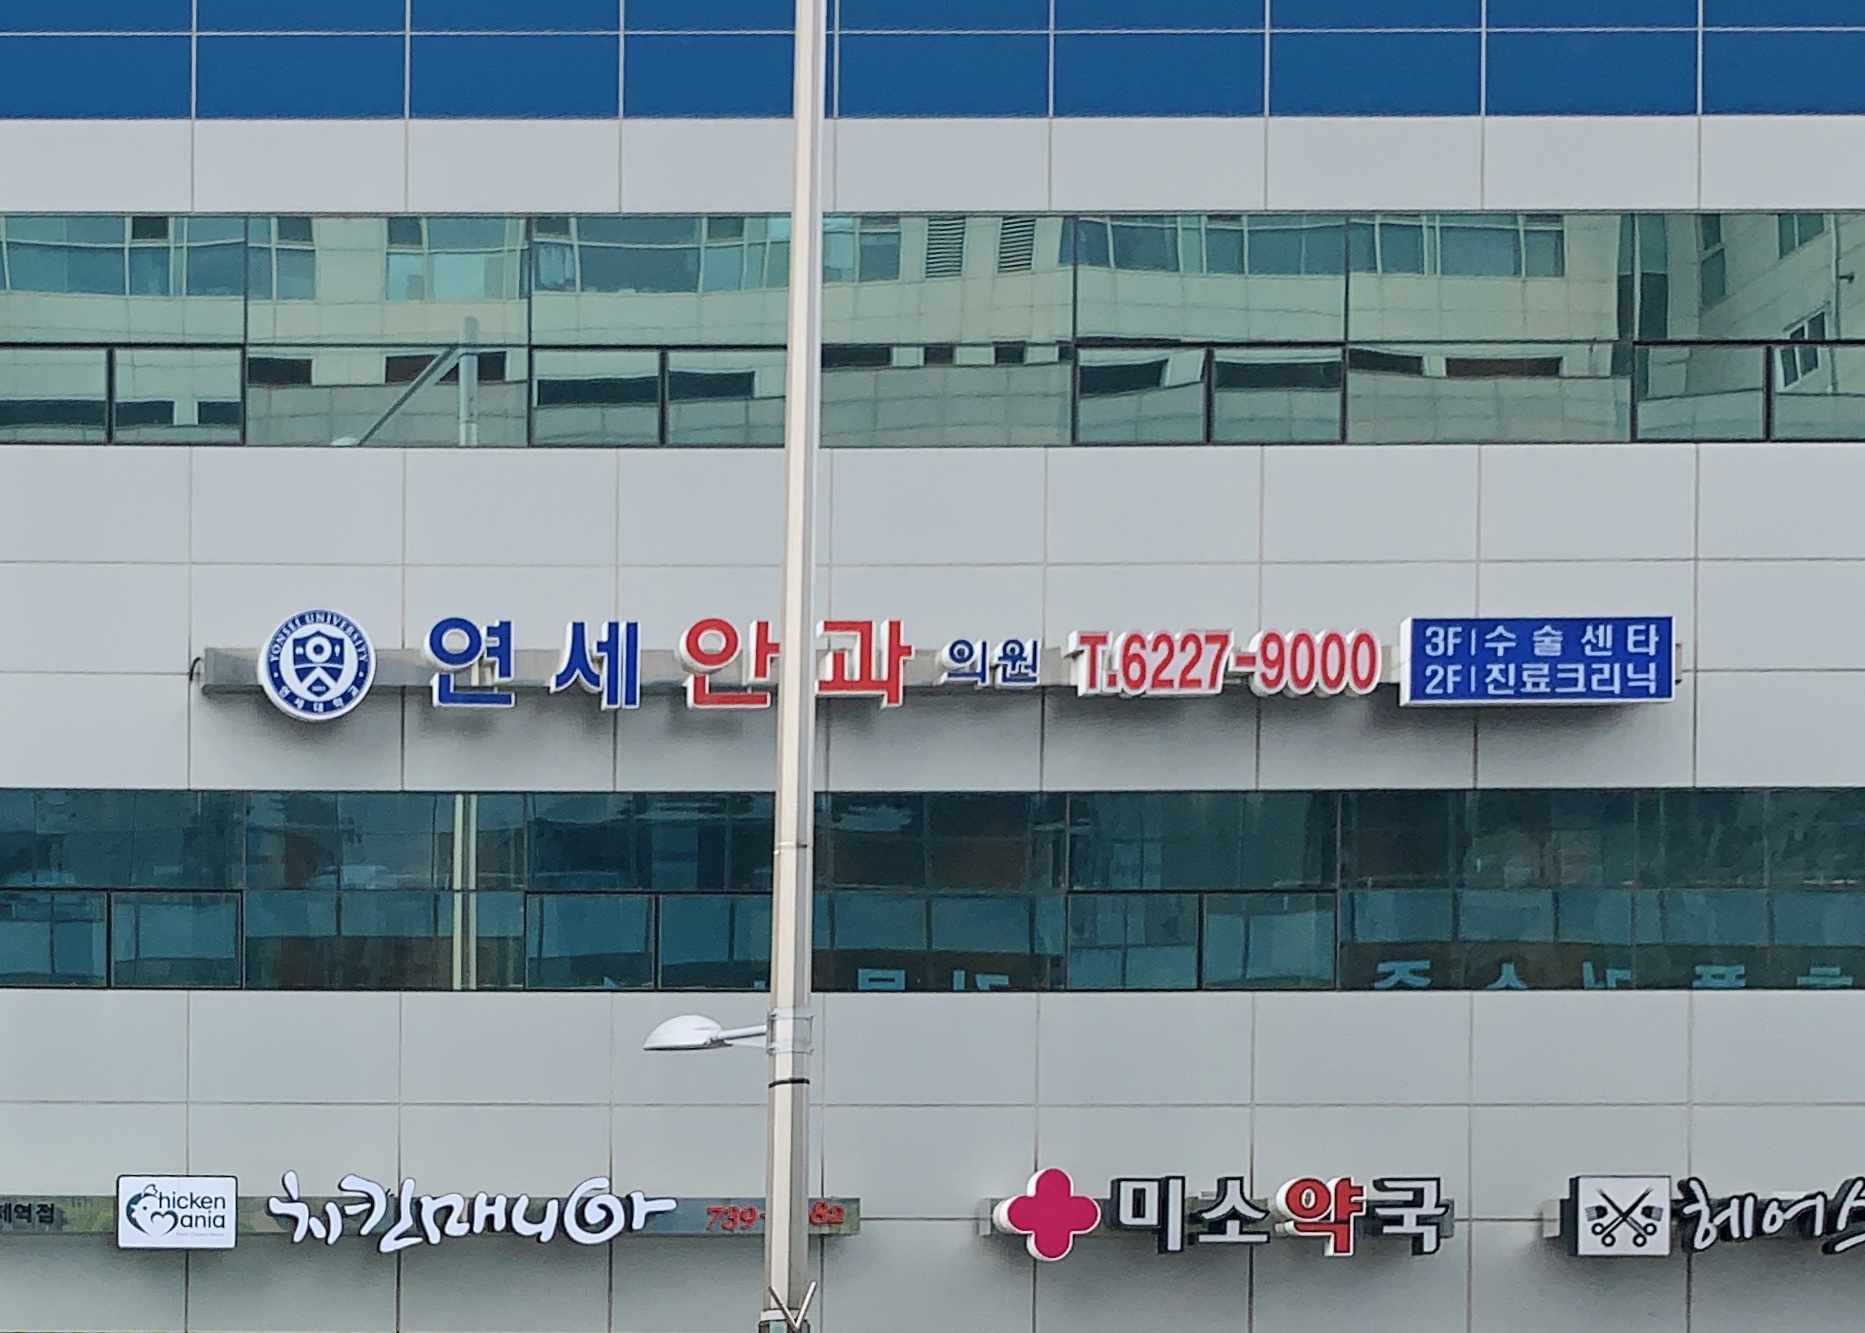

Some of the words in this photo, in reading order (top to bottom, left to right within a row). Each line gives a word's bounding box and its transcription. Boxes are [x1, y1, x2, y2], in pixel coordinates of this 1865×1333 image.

[270, 619, 302, 662] YONSEI
[304, 613, 369, 662] UNIVERSITY
[1425, 624, 1463, 657] 3F
[944, 639, 1041, 688] 의원
[1425, 664, 1463, 694] 2F
[1484, 663, 1658, 695] 진료크리닉
[1112, 1175, 1449, 1256] 미소약국
